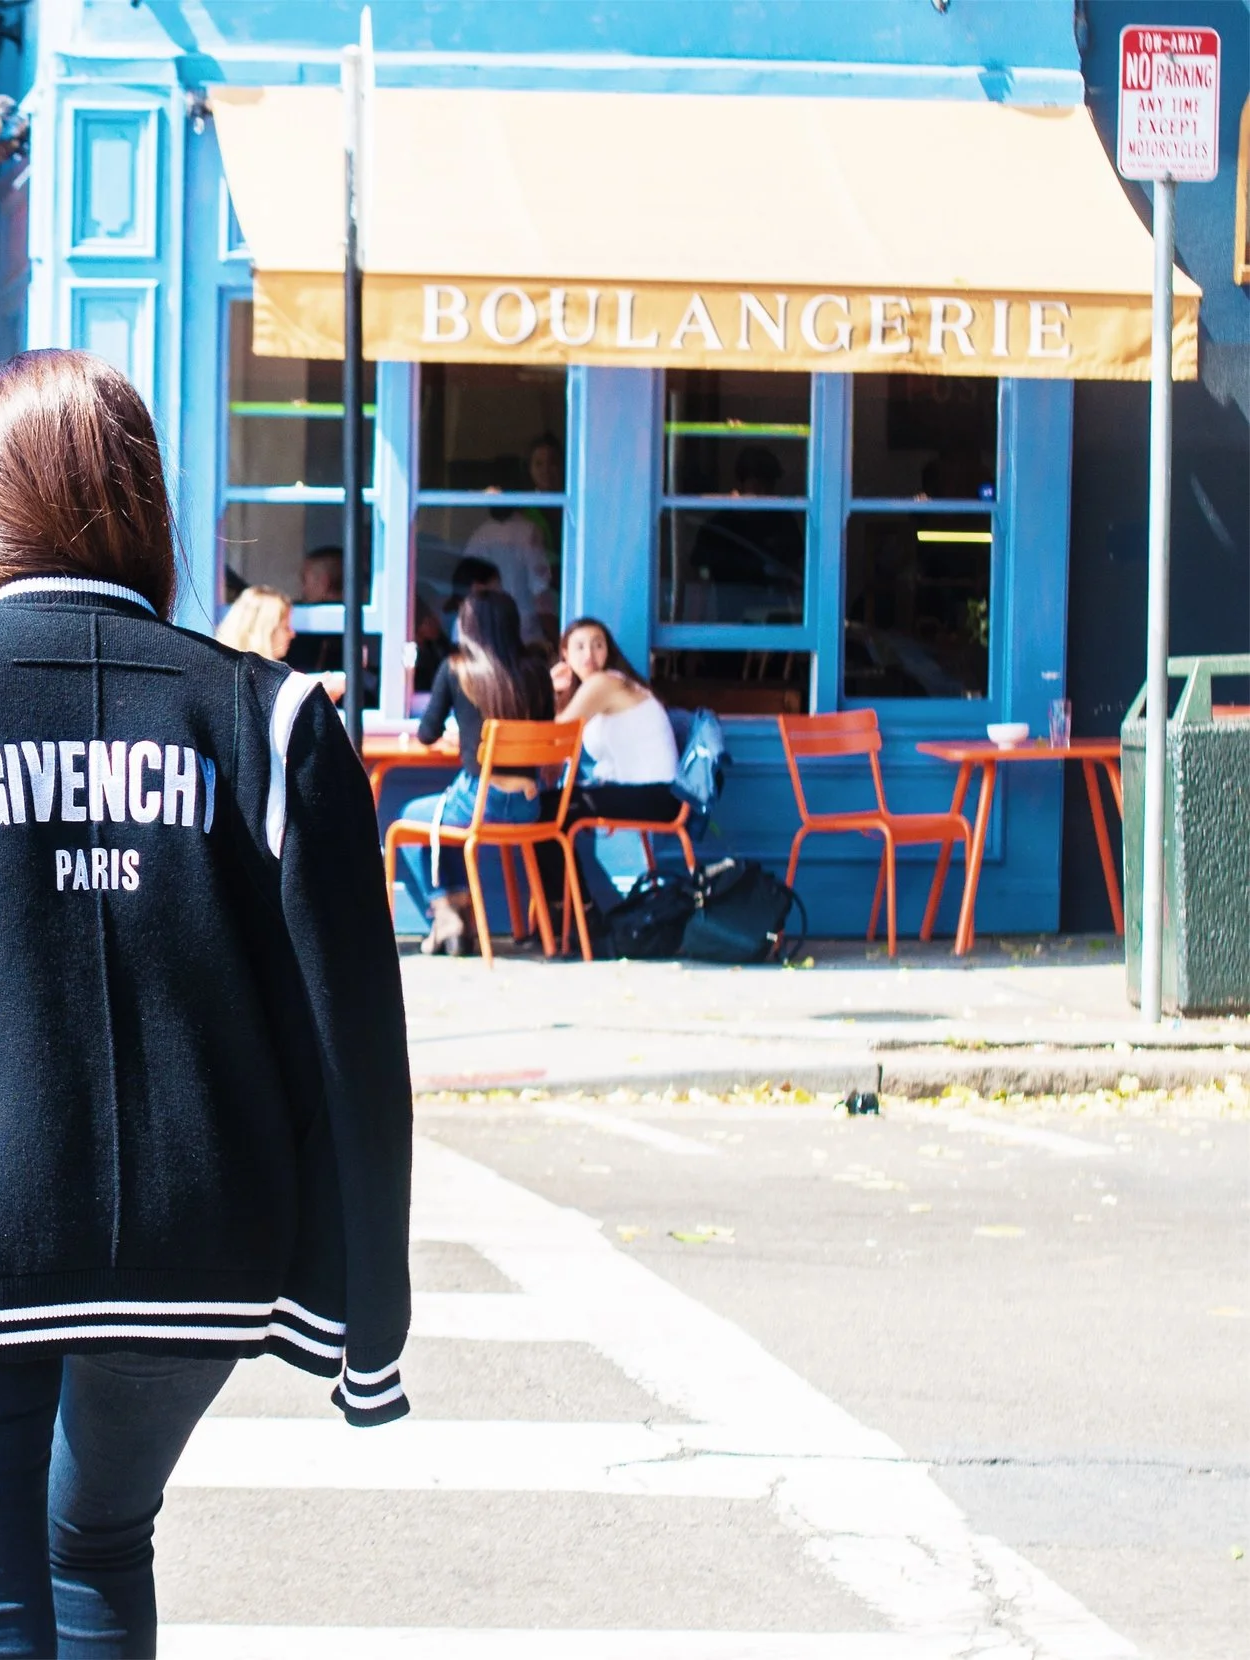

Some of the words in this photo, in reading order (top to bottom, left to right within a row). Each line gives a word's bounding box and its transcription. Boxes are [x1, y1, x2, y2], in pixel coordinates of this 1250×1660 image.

[1138, 32, 1202, 53] TOW-AWAY
[1126, 52, 1151, 89] NO
[1156, 62, 1212, 89] PARKING
[1138, 95, 1165, 113] ANY
[1171, 96, 1200, 115] TIME
[1137, 118, 1199, 137] EXCEPT
[1128, 139, 1209, 160] MOTORCYCLES
[421, 284, 1073, 358] BOULANGERIE
[55, 848, 140, 891] PARIS
